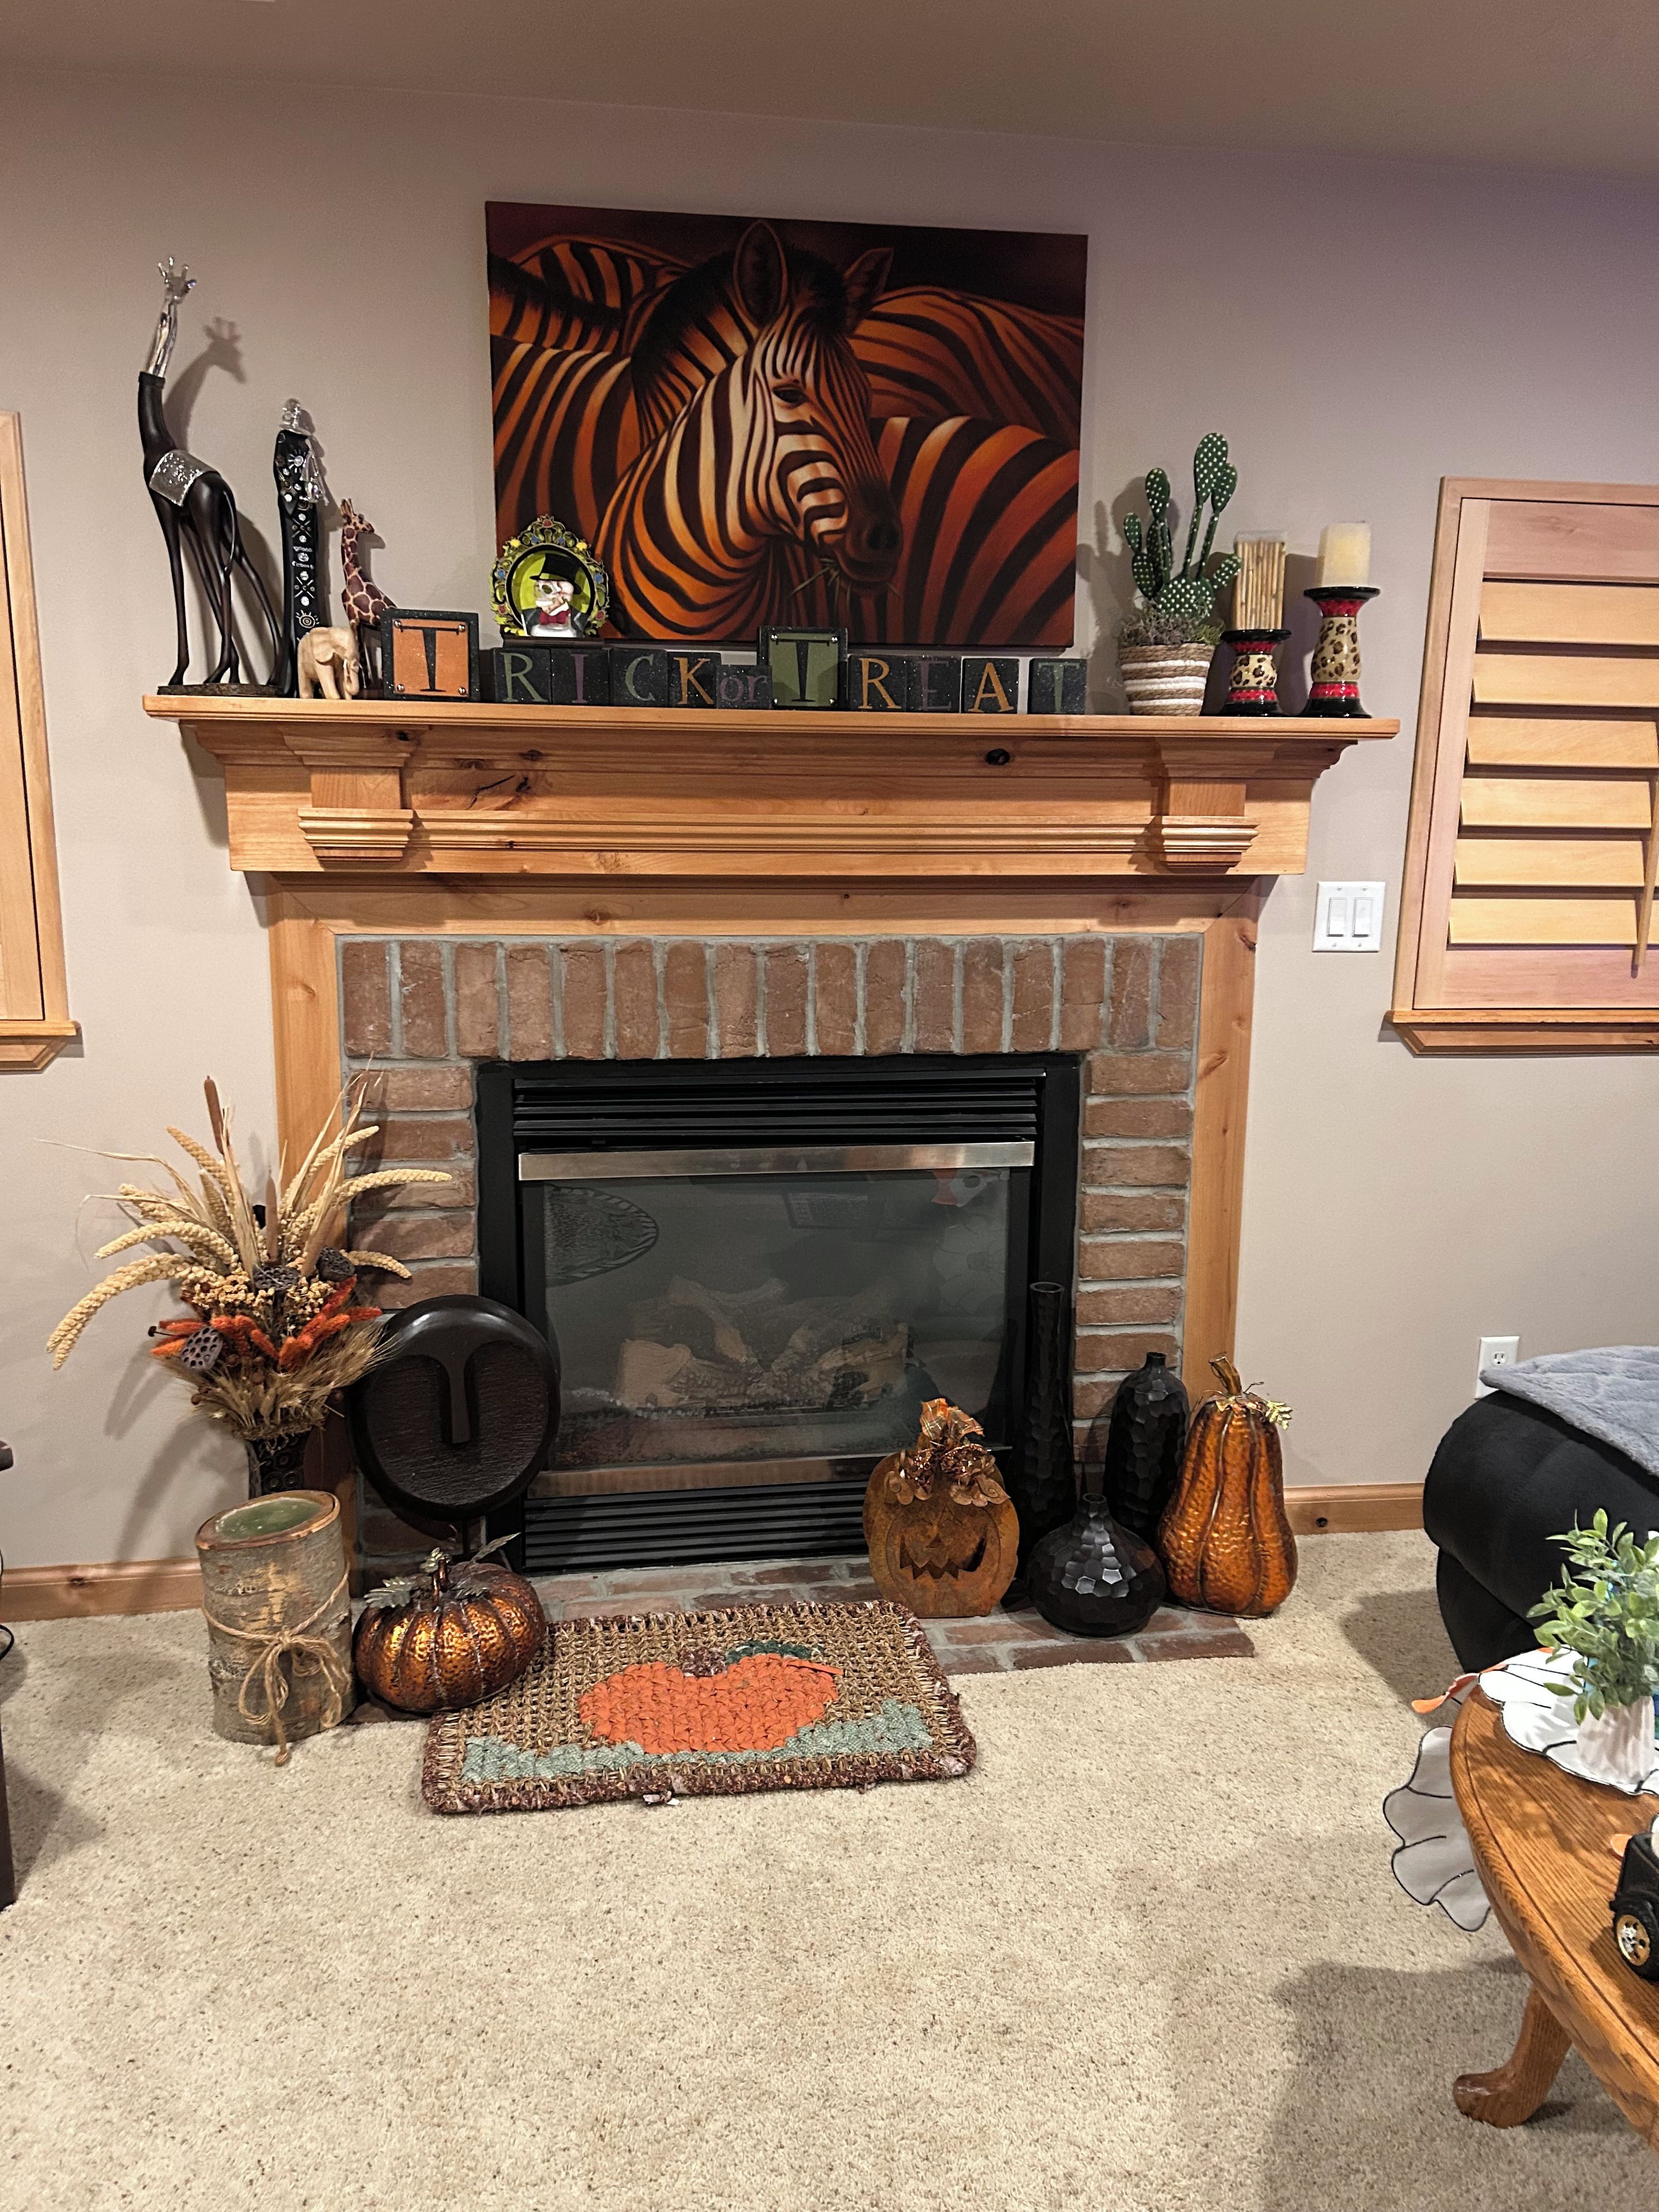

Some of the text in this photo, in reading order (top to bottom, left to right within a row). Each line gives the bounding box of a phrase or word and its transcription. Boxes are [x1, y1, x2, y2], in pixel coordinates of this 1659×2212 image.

[400, 624, 1080, 714] TRICK or TREAT
